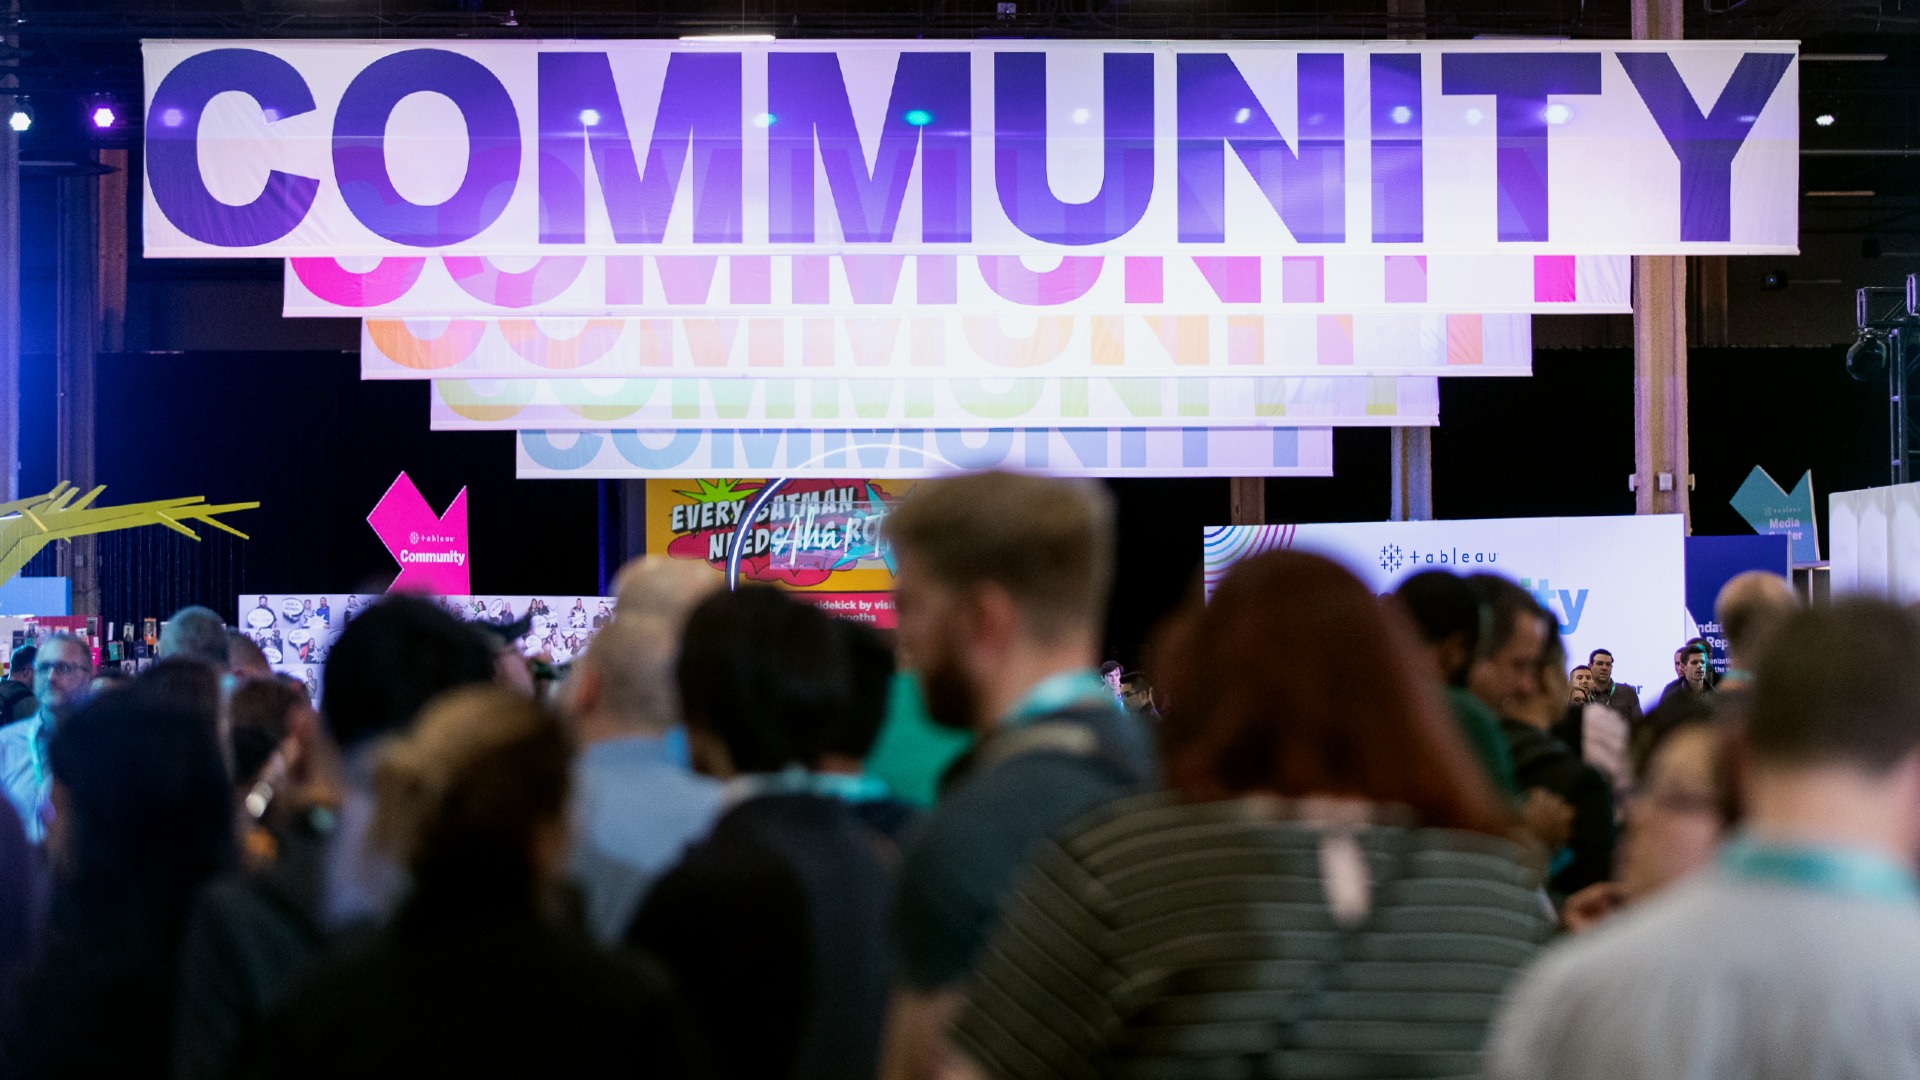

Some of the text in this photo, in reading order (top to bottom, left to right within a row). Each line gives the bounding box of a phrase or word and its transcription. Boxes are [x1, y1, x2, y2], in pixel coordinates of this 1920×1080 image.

[145, 48, 1796, 248] COMMUNITY
[671, 499, 746, 532] EVERY
[1769, 518, 1800, 529] Media
[400, 549, 466, 567] Community
[1410, 547, 1497, 565] tableau
[859, 600, 873, 612] by
